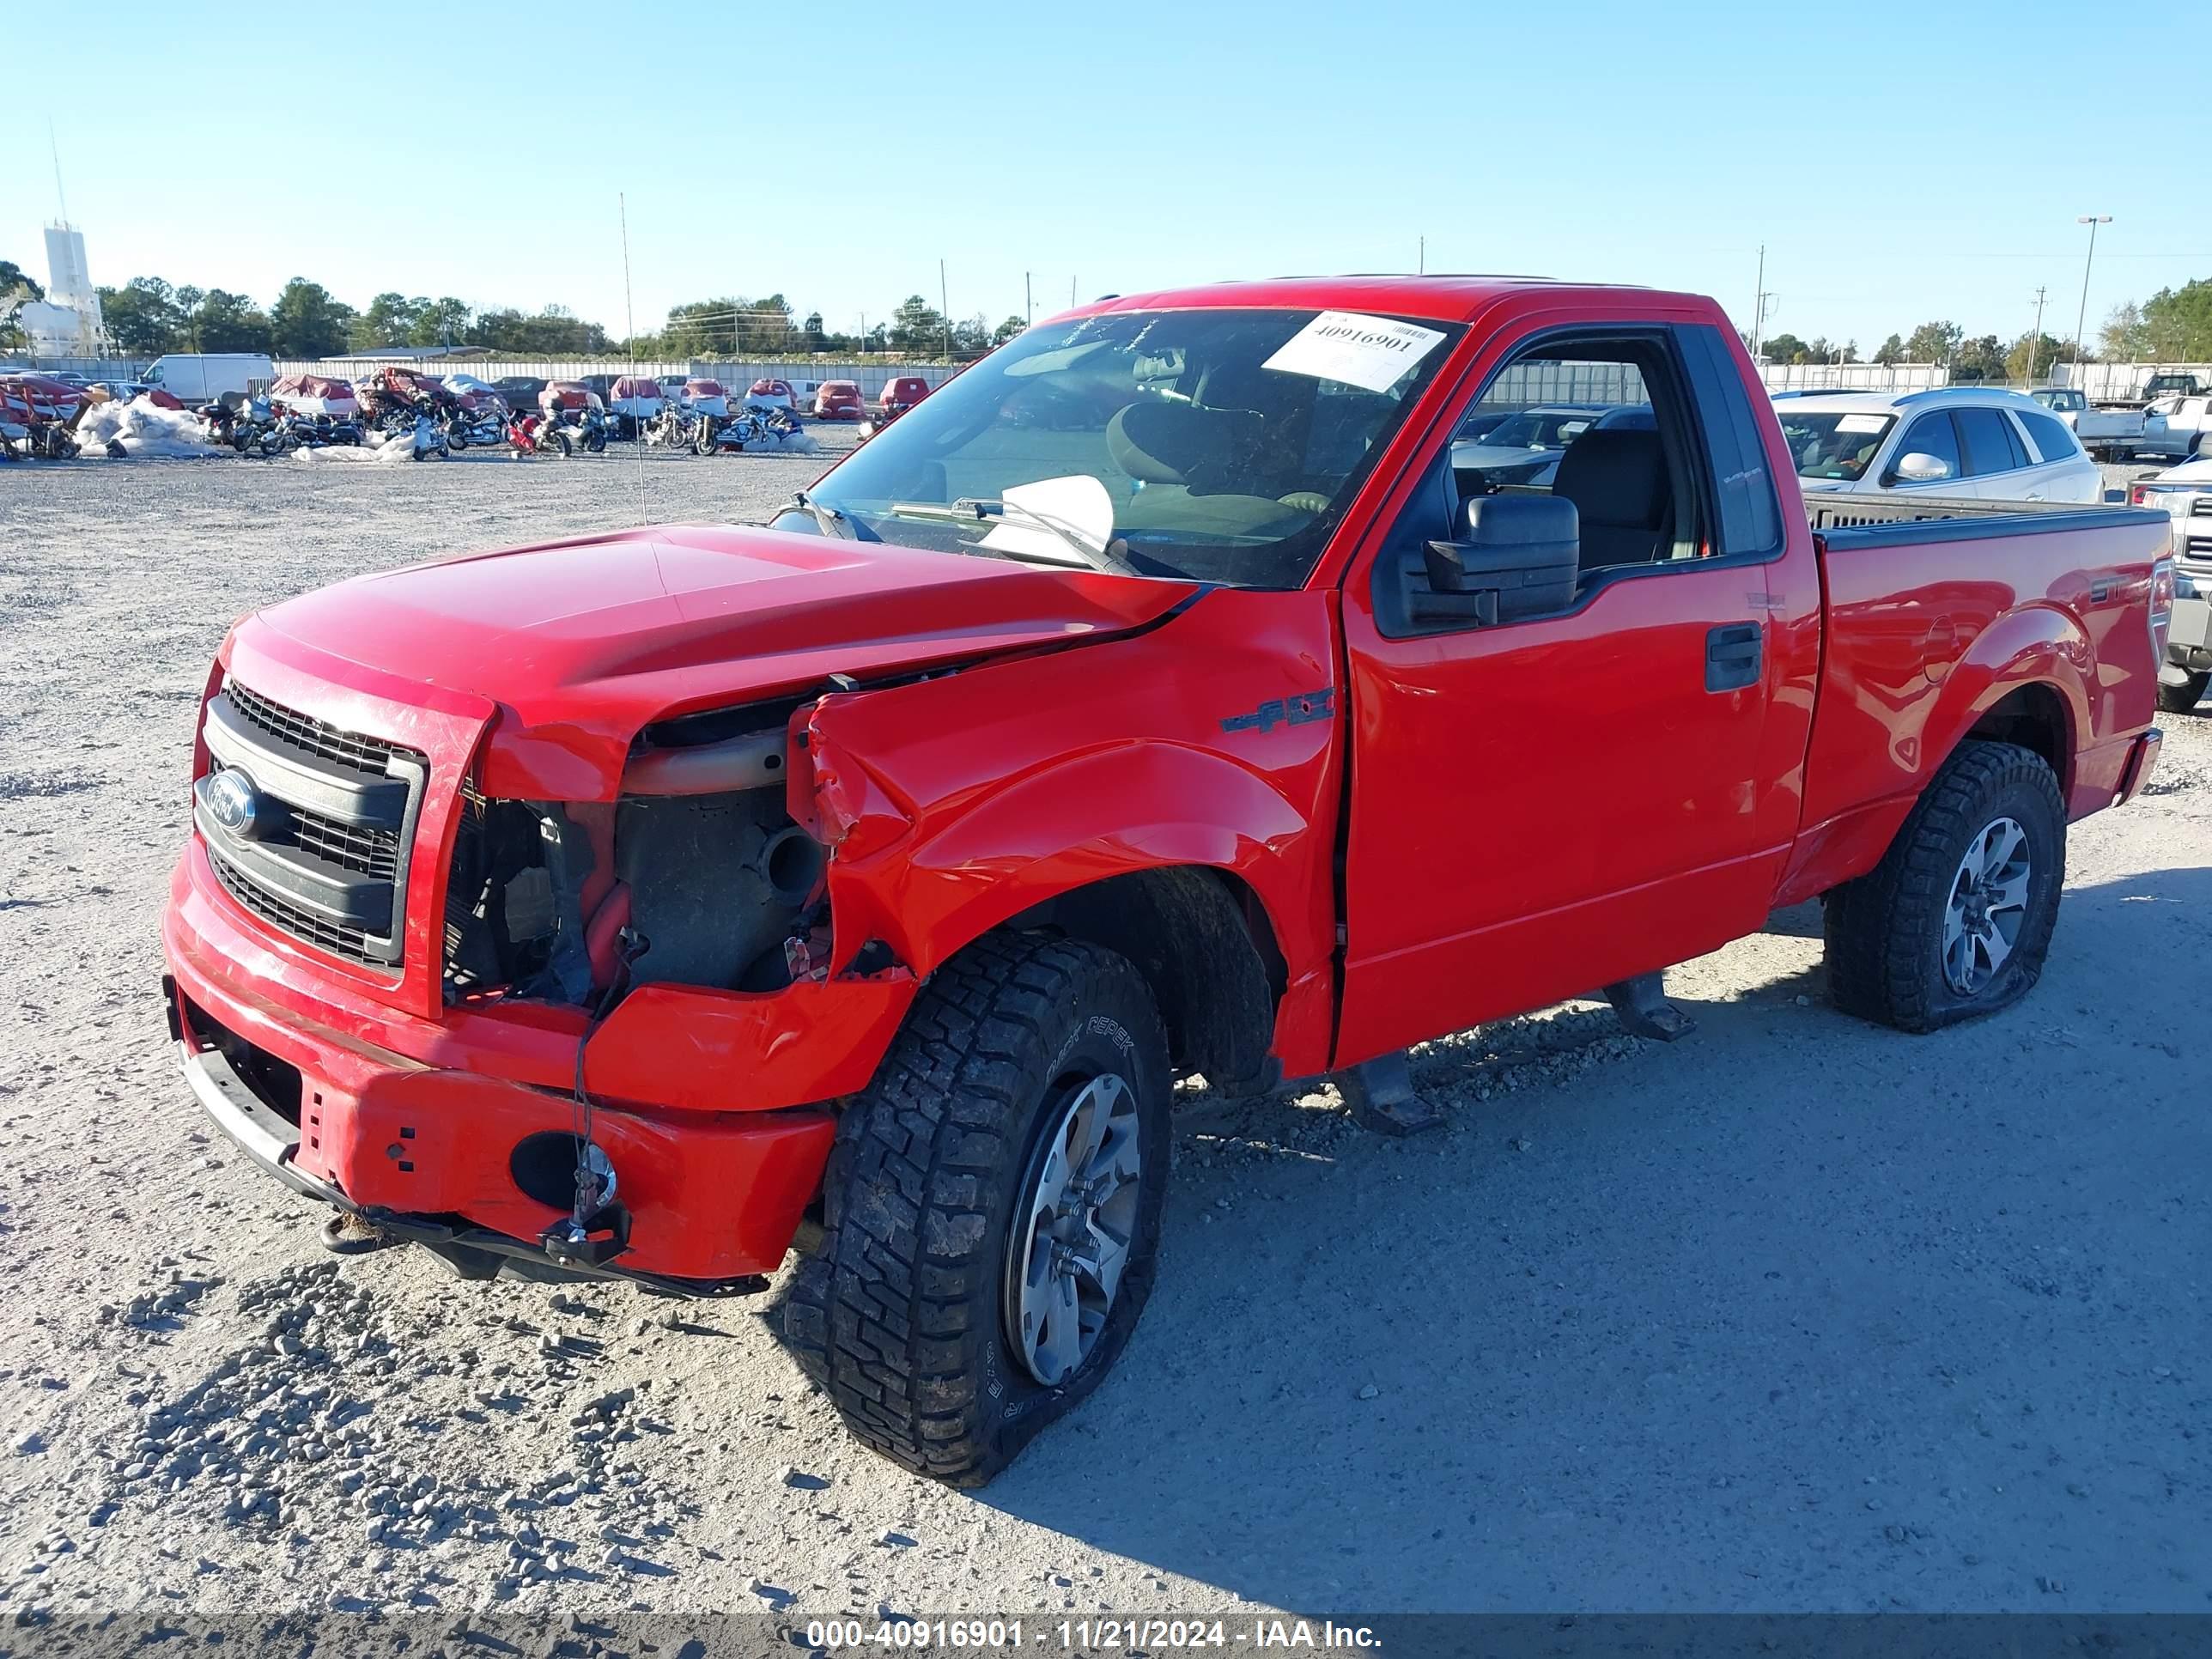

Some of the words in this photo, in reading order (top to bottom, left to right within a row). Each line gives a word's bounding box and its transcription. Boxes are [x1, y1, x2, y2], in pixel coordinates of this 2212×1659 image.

[1314, 325, 1413, 353] 40916901
[210, 779, 234, 822] Ford
[1085, 1016, 1134, 1058] CEPEK
